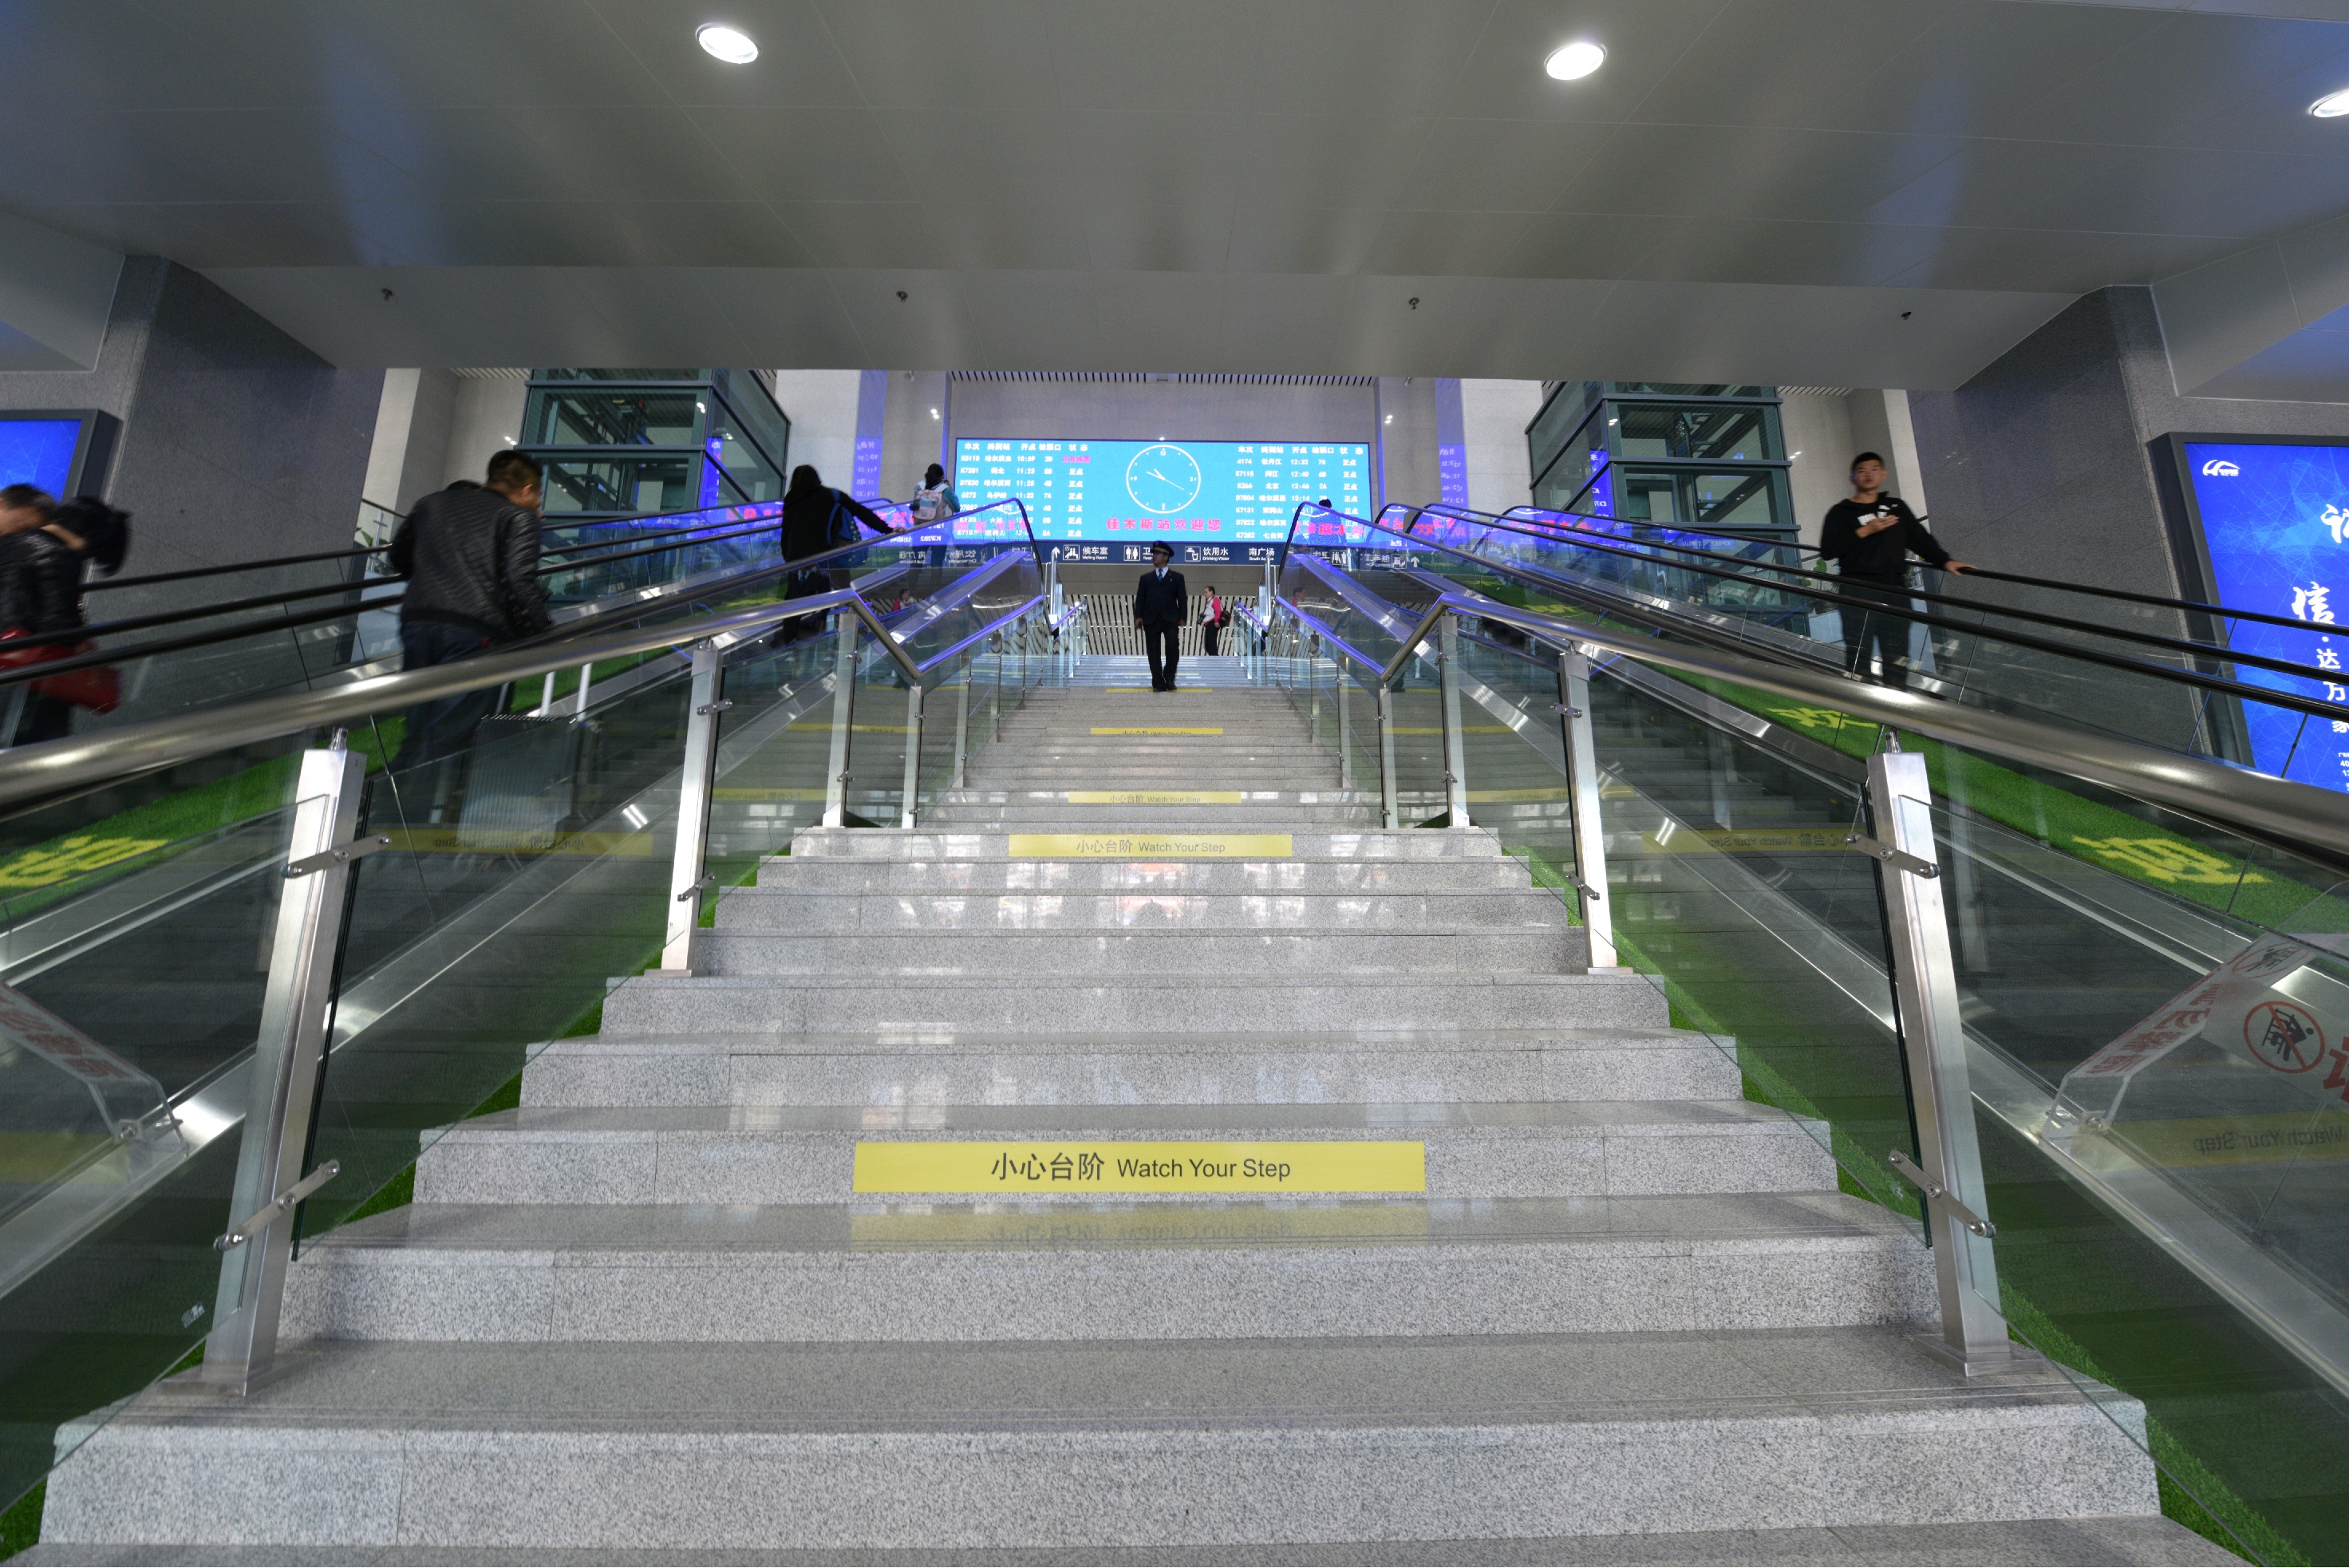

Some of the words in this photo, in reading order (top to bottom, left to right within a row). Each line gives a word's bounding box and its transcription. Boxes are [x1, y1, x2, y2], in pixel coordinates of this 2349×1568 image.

[1107, 518, 1221, 531] 佳木斯站欢迎您
[1083, 546, 1107, 555] 候车室
[1076, 839, 1133, 853] 小心台阶
[1139, 843, 1171, 852] Watch
[1174, 843, 1198, 852] Your
[1202, 843, 1226, 854] Step
[990, 1151, 1105, 1181] 小心台阶
[1117, 1158, 1185, 1179] Watch
[1190, 1158, 1238, 1179] Your
[1242, 1158, 1291, 1182] Step
